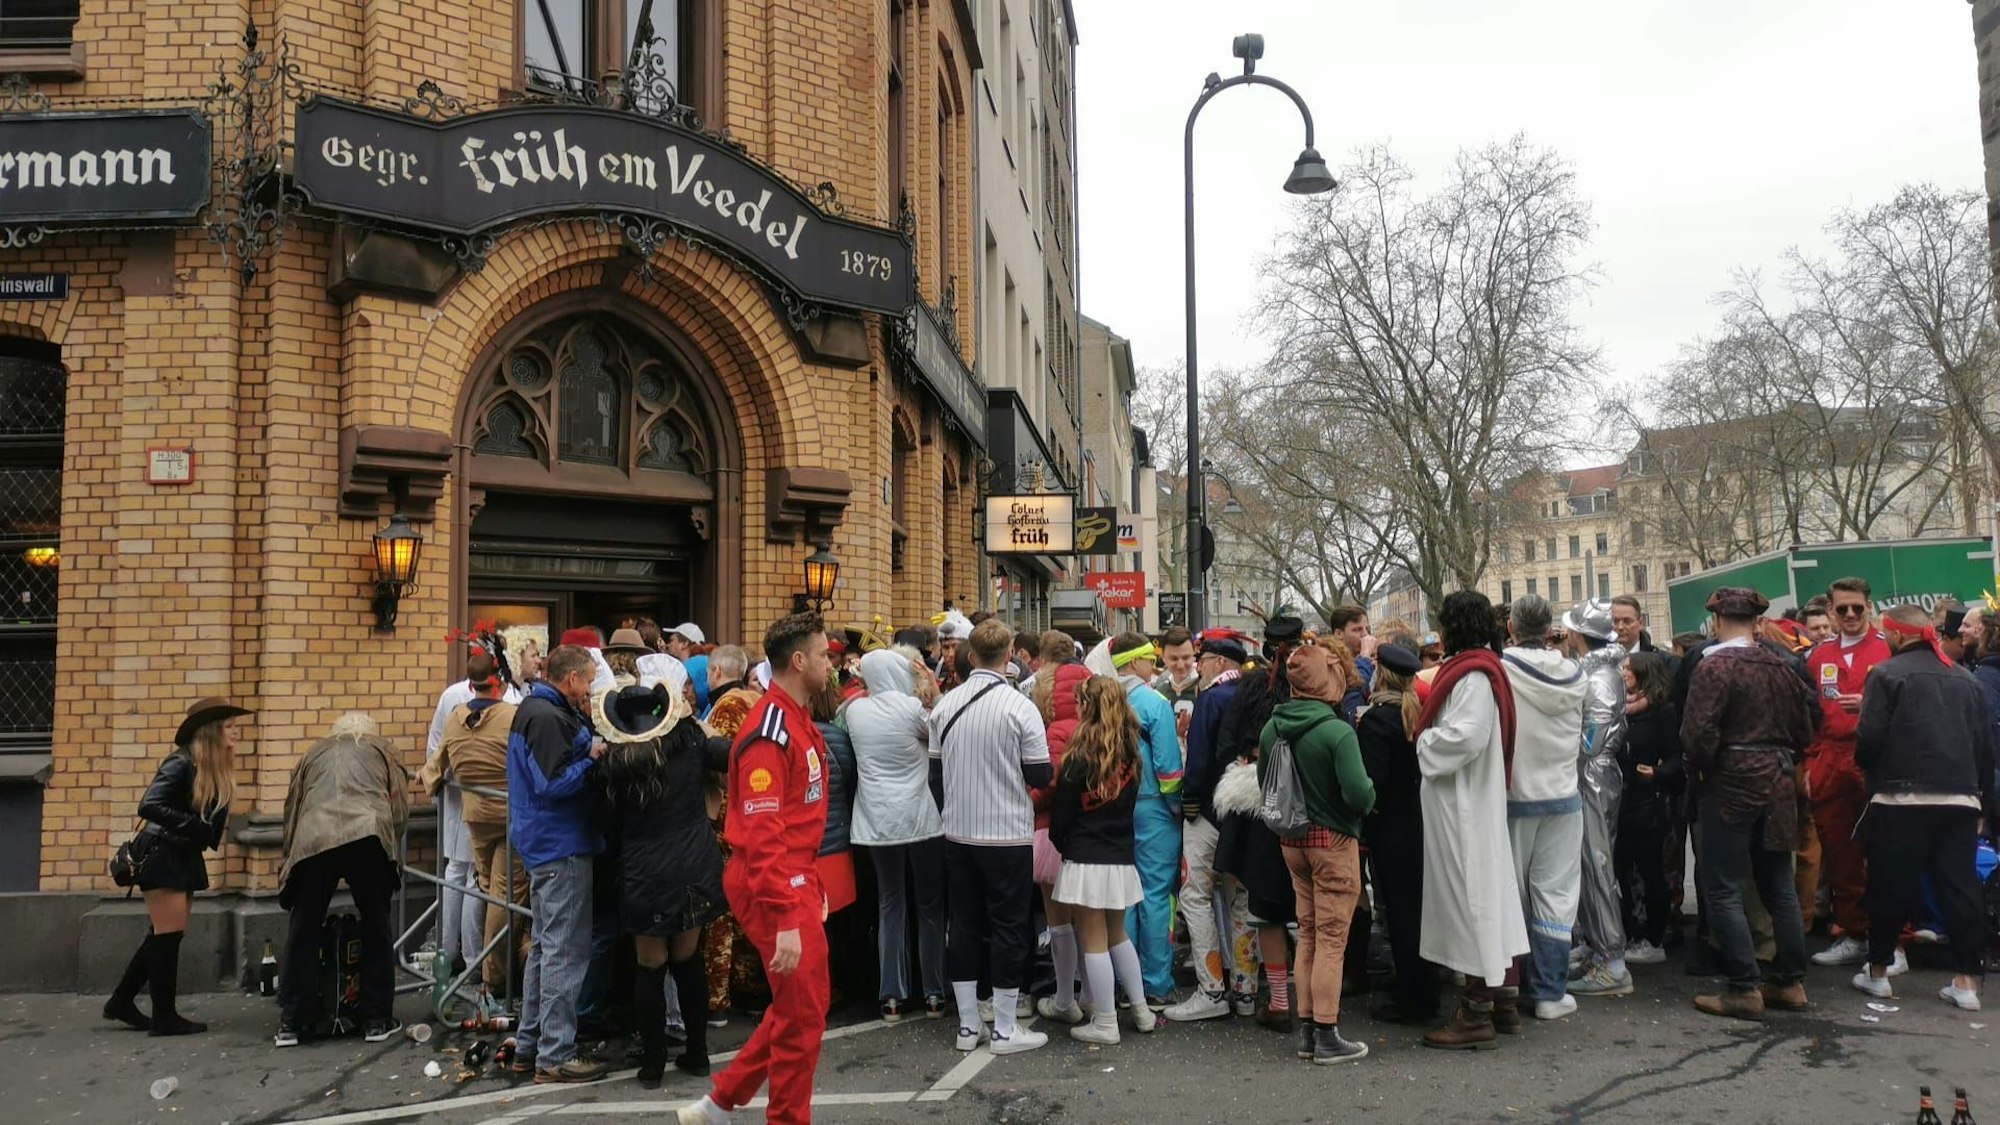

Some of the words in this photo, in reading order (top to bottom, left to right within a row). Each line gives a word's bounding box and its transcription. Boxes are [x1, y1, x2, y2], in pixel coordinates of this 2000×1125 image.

[0, 148, 176, 190] rmann
[321, 136, 429, 187] Gegr.
[598, 152, 658, 191] em
[666, 145, 808, 260] Veedel
[841, 249, 892, 281] 1879
[0, 275, 54, 293] inswall
